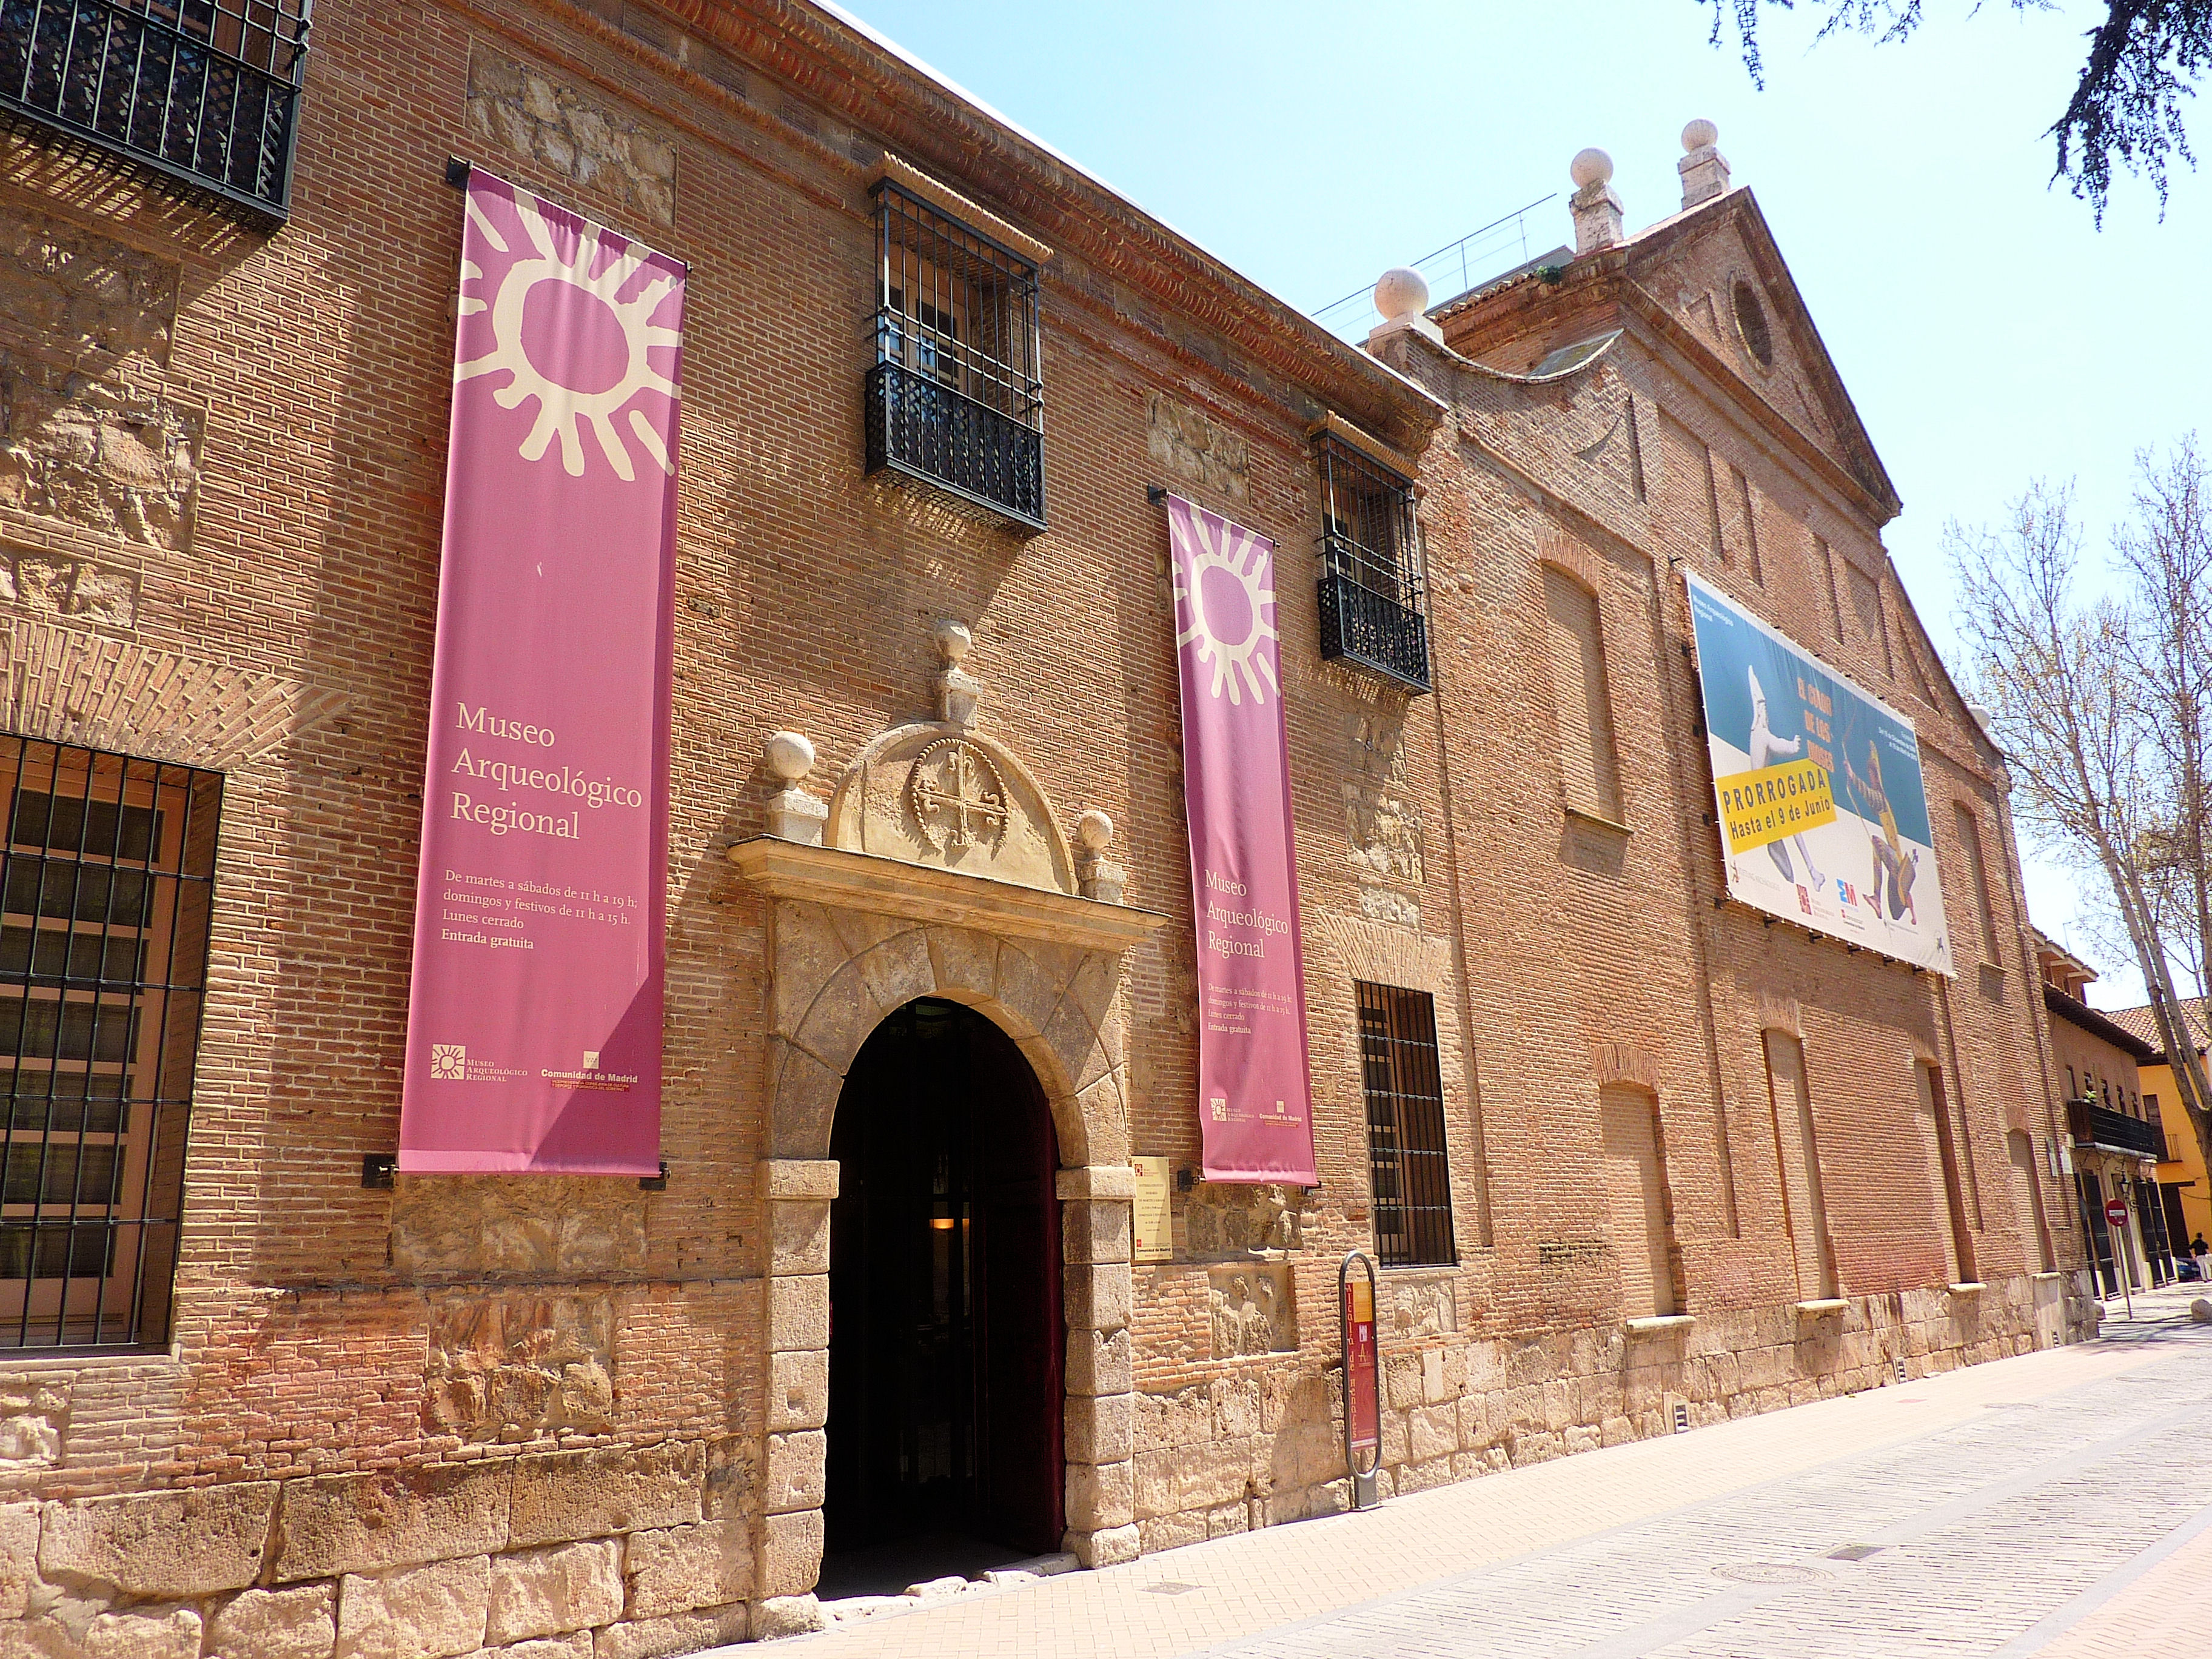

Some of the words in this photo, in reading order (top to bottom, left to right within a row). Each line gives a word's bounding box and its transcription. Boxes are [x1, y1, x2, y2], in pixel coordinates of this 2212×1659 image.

[455, 702, 555, 747] Museo
[451, 748, 643, 809] Arqueológico
[1723, 768, 1826, 814] PRORROGADA
[450, 791, 580, 839] Regional
[1730, 817, 1763, 840] Hasta
[1766, 810, 1775, 828] el
[1779, 807, 1785, 825] 9
[1789, 805, 1801, 822] de
[1805, 796, 1830, 817] Junio
[445, 870, 463, 882] De
[465, 873, 505, 888] martes
[508, 880, 515, 890] a
[517, 880, 561, 896] sábados
[564, 886, 577, 898] de
[593, 891, 600, 902] h
[603, 894, 609, 903] a
[612, 896, 625, 908] 19
[628, 896, 638, 909] h;
[1204, 869, 1247, 896] Museo
[443, 888, 502, 908] domingos
[505, 900, 512, 910] y
[515, 897, 556, 914] festivos
[559, 904, 572, 916] de
[588, 908, 595, 920] h
[598, 912, 605, 921] a
[608, 914, 618, 925] 15
[621, 913, 631, 925] h.
[443, 909, 478, 923] Lunes
[481, 916, 524, 929] cerrado
[1206, 900, 1288, 936] Arqueológico
[441, 928, 487, 944] Entrada
[490, 936, 534, 949] gratuita
[1208, 930, 1265, 959] Regional
[1208, 996, 1232, 1008] domingos
[1239, 1000, 1259, 1010] festivos
[1239, 988, 1260, 997] sábados
[1208, 1009, 1222, 1019] Lunes
[1223, 1012, 1245, 1021] cerrado
[1208, 1022, 1228, 1032] Entrada
[1229, 1025, 1252, 1034] gratuita
[466, 1074, 507, 1082] REGIONAL
[541, 1069, 592, 1080] Comunidad
[608, 1073, 638, 1083] Madrid
[1349, 1351, 1355, 1371] de
